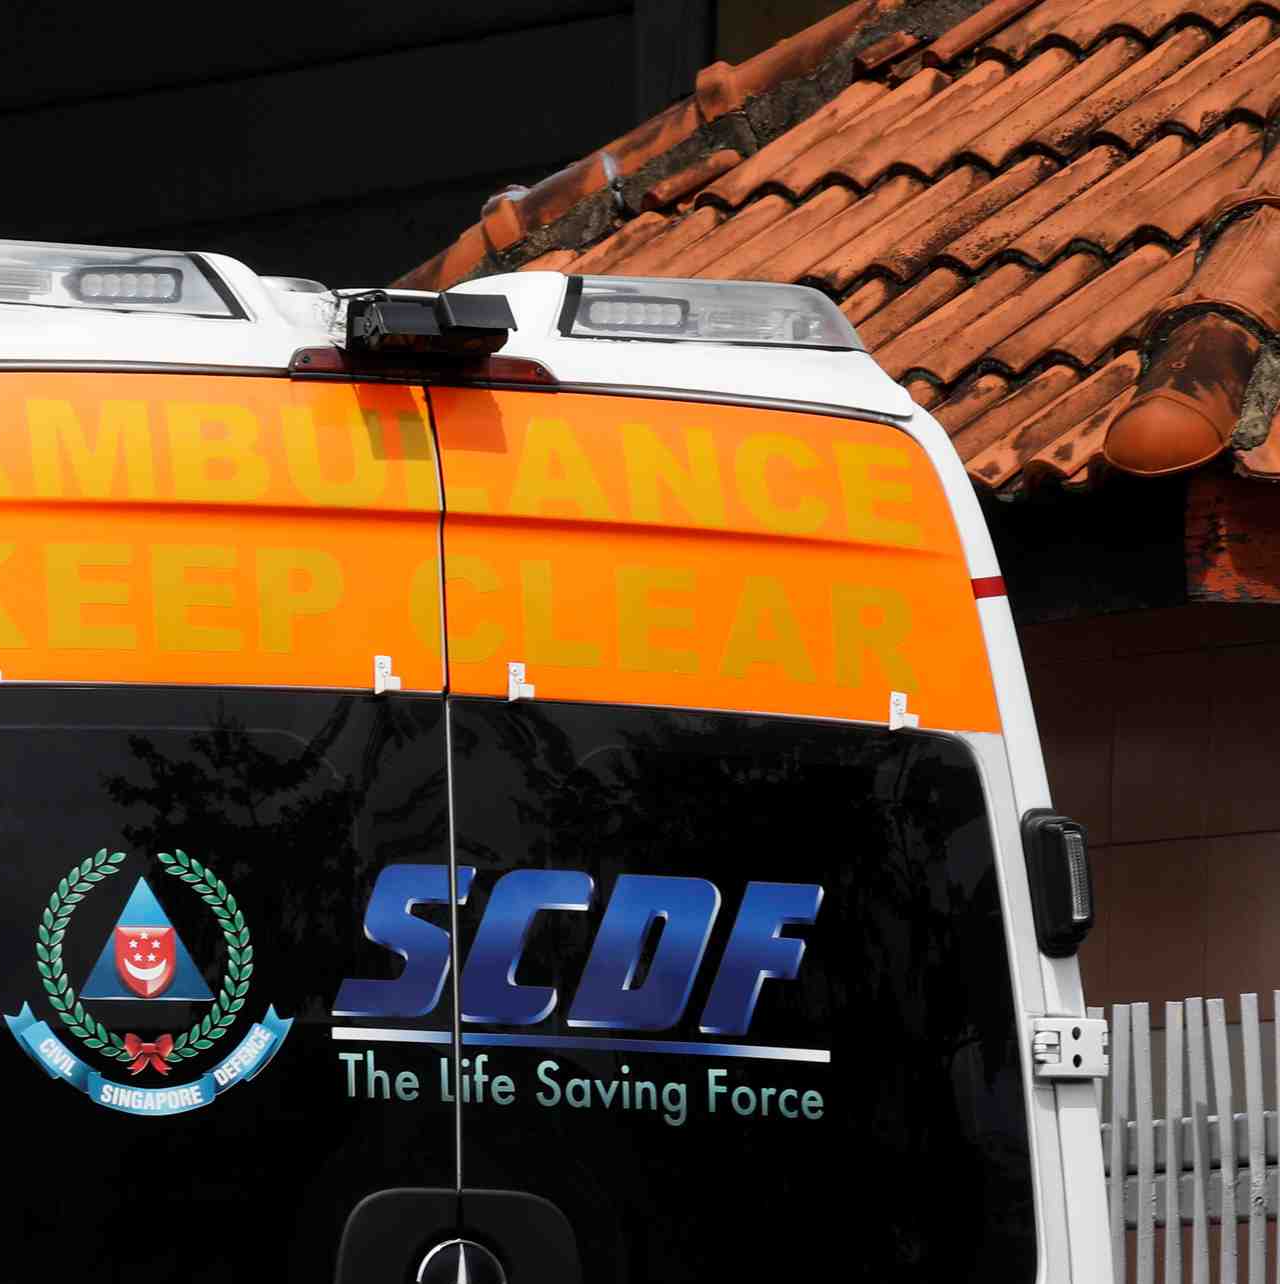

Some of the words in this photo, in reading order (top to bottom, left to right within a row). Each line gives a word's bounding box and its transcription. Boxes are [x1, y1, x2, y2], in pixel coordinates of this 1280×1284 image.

[408, 554, 918, 692] CLEAR
[331, 863, 825, 1036] SCDF
[41, 1038, 79, 1077] CIVIL
[100, 1083, 204, 1111] SINGAPORE
[213, 1025, 272, 1086] DEFENCE
[338, 1050, 420, 1101] The
[440, 1053, 516, 1106] Life
[536, 1060, 688, 1127] Saving
[707, 1068, 825, 1120] Force
